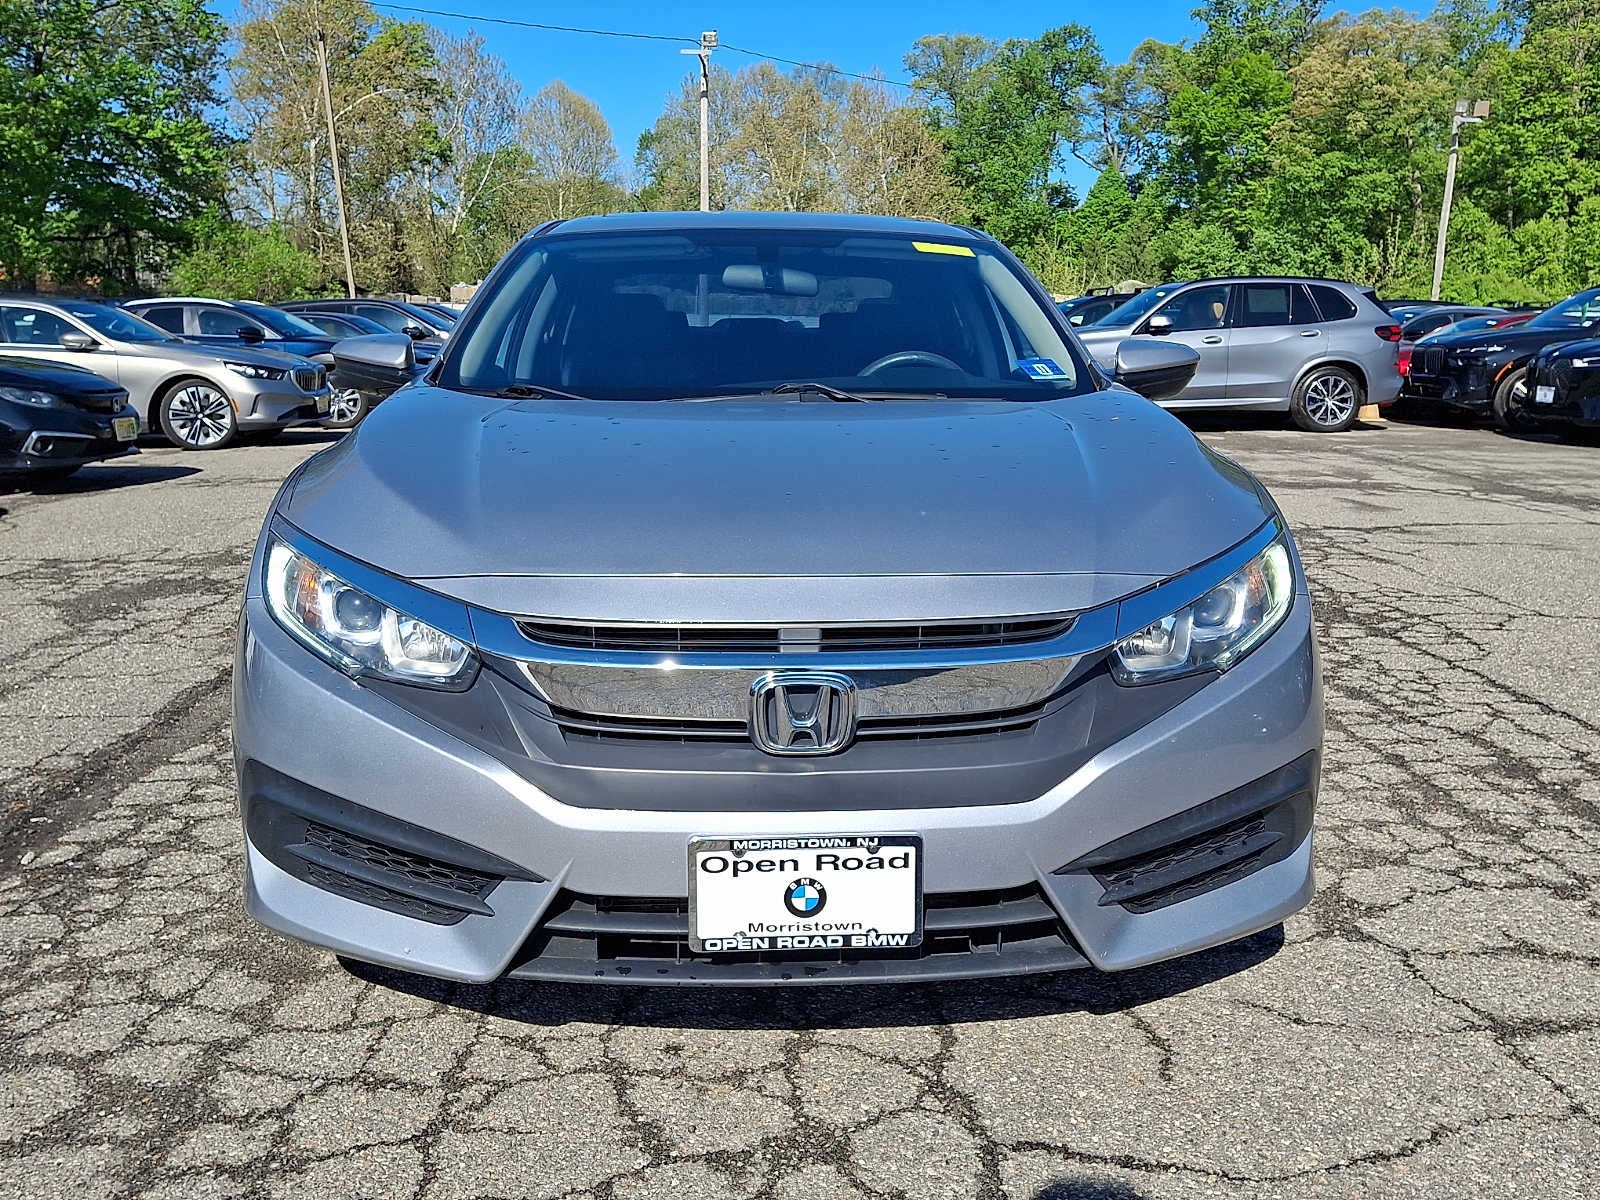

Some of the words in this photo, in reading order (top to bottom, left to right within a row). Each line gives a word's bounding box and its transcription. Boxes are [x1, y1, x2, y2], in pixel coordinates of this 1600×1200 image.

[856, 837, 879, 847] NJ
[700, 855, 799, 877] Open
[815, 852, 910, 871] Road
[789, 878, 823, 891] BMW
[748, 922, 863, 933] Morristown
[704, 937, 775, 951] OPEN
[776, 935, 844, 949] ROAD
[851, 934, 909, 947] BMW
